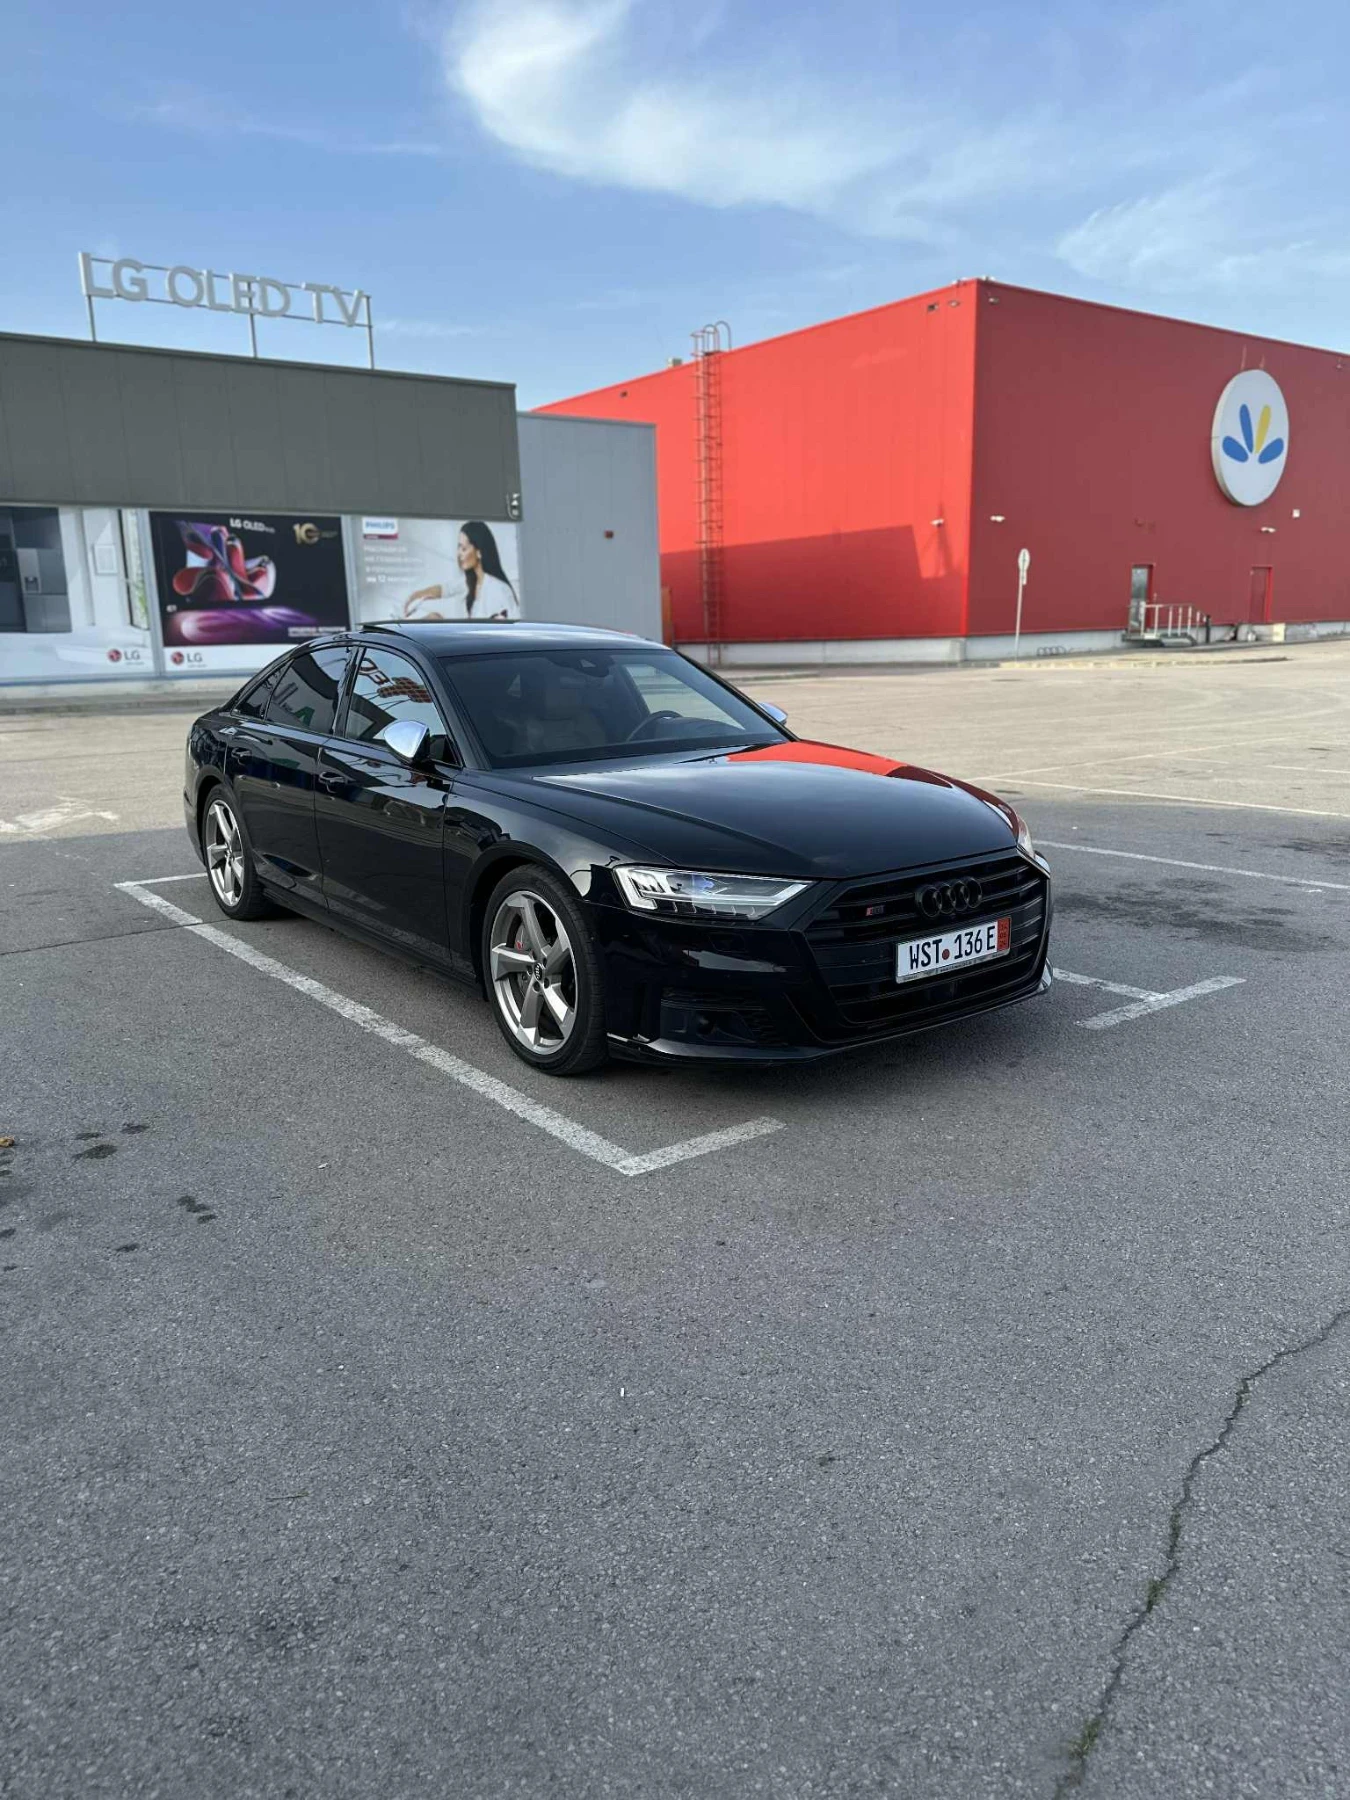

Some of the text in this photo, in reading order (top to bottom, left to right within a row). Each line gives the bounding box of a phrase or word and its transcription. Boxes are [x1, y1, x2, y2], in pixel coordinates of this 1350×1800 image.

[79, 252, 365, 327] LG OLED TV
[229, 518, 242, 528] LG
[124, 649, 141, 661] LG
[186, 652, 203, 663] LG
[909, 938, 943, 970] WST
